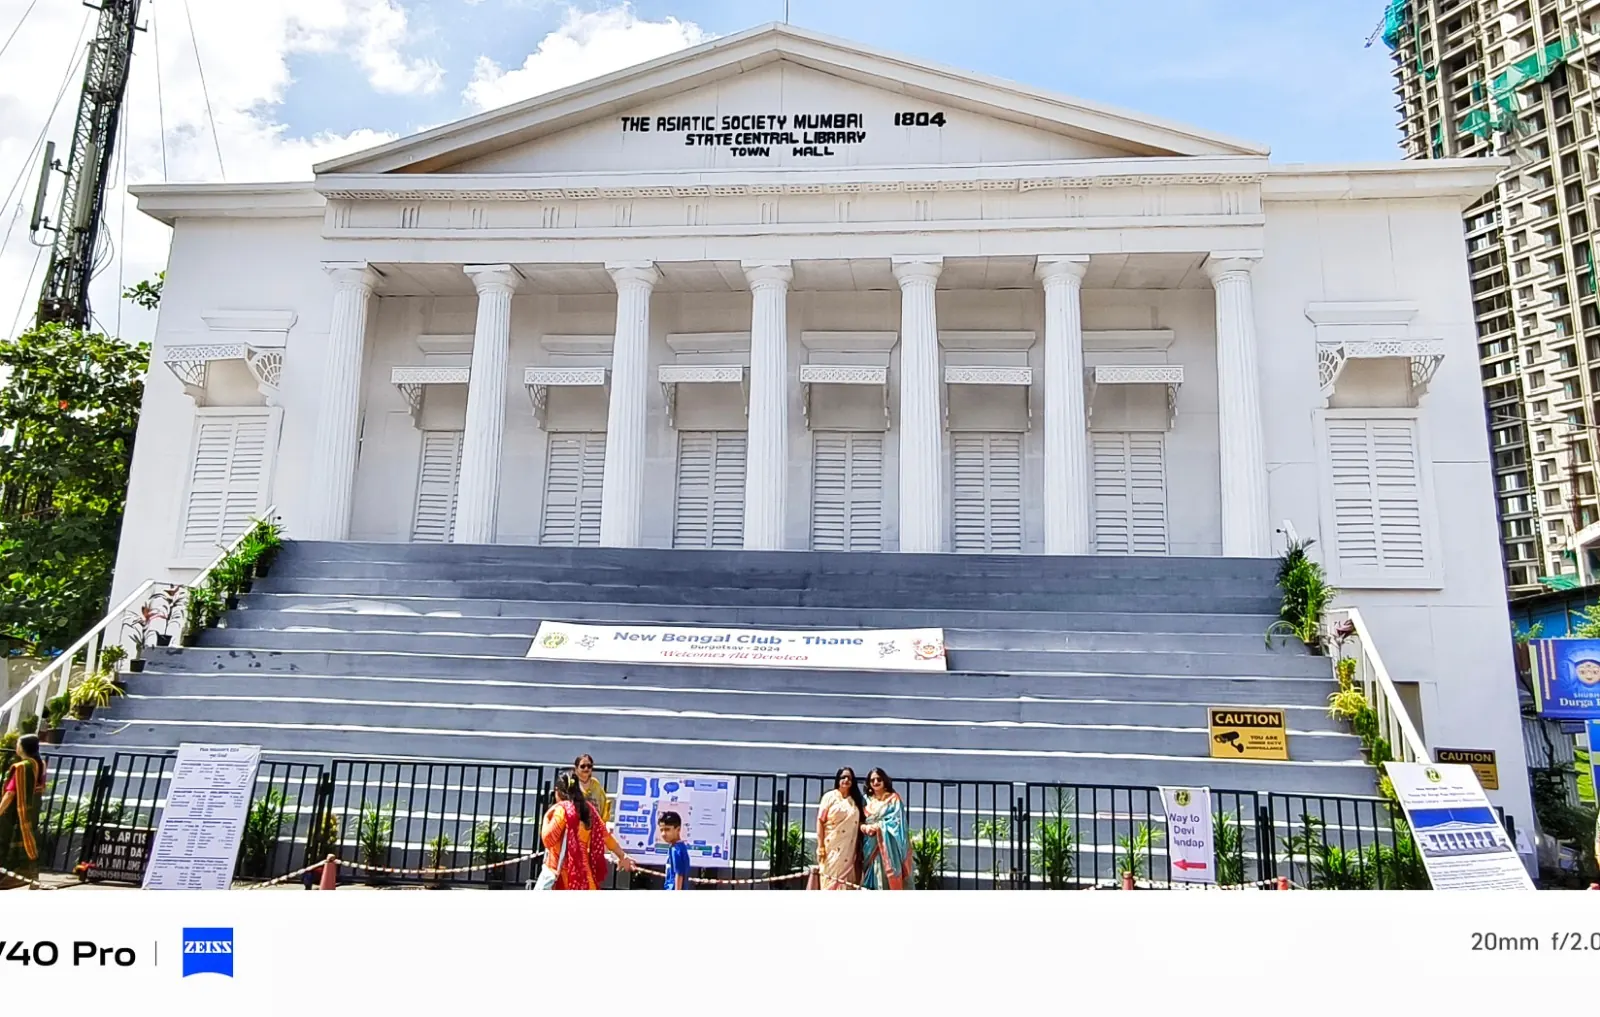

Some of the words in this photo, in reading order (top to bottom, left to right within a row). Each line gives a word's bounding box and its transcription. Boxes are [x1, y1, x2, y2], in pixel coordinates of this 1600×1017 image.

[621, 116, 650, 132] THE
[656, 115, 716, 132] ASIATIC
[721, 114, 787, 131] SOCIETY
[793, 113, 864, 130] MUMBAI
[893, 111, 947, 127] 1804
[684, 132, 733, 146] STATE
[735, 131, 800, 145] CENTRAL
[803, 130, 867, 144] LIBRARY
[729, 146, 770, 158] TOWN
[792, 146, 835, 157] HALL
[613, 631, 657, 642] New
[661, 632, 732, 645] Bengal
[736, 634, 783, 645] Club
[802, 635, 865, 646] Thane
[660, 650, 727, 659] Welcomes
[1559, 697, 1594, 709] Durga
[1215, 713, 1280, 725] CAUTION
[1440, 751, 1492, 762] CAUTION
[1190, 814, 1200, 823] to
[1173, 825, 1195, 835] Devi
